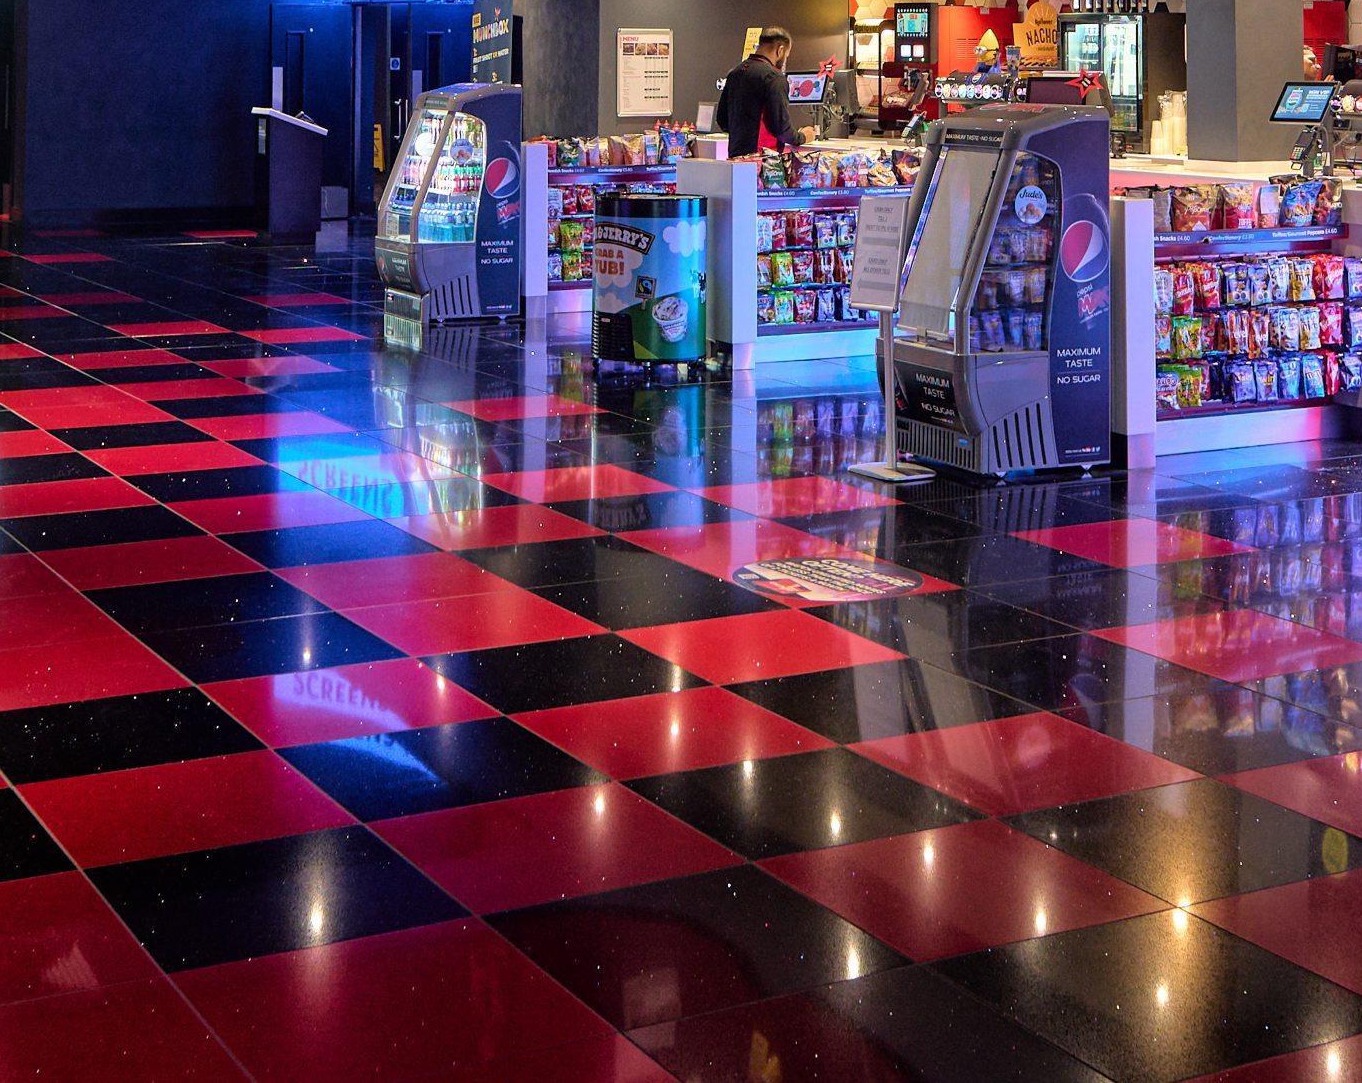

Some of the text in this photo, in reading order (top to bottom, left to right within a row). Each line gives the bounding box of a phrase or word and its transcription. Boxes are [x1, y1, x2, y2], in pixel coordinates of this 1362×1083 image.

[473, 18, 509, 43] MUNCHBOX
[1018, 189, 1043, 200] Jude's
[616, 249, 624, 259] A
[1056, 346, 1101, 358] MAXIMUM
[1065, 358, 1093, 368] TASTE
[915, 373, 949, 389] MAXIMUM
[1057, 374, 1101, 385] NO SUGAR
[923, 386, 945, 399] TASTE
[921, 403, 955, 417] NO SUGAR
